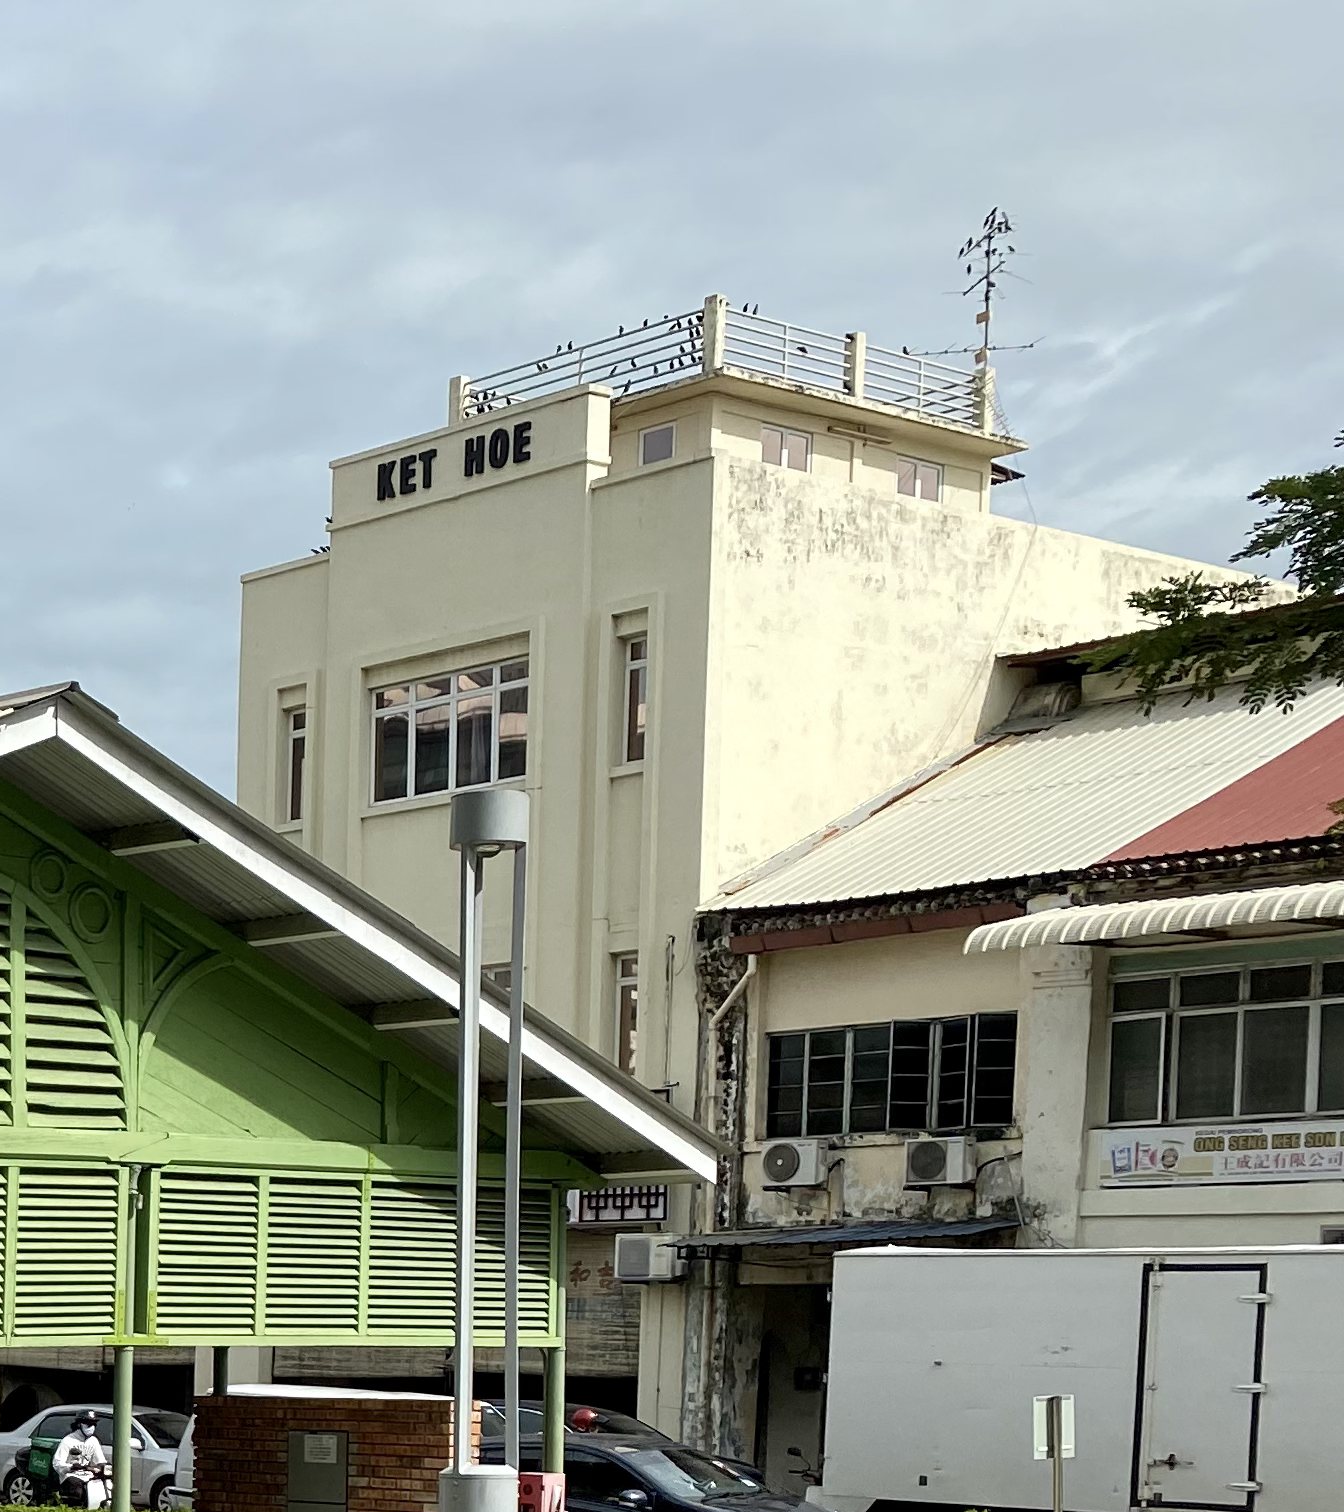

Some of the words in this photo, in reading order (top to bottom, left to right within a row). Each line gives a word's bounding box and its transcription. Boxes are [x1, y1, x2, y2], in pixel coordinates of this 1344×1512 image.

[377, 448, 438, 501] KET
[464, 421, 532, 477] HOE
[1194, 1136, 1225, 1152] ONG
[1228, 1134, 1268, 1151] SENG
[1272, 1133, 1301, 1149] KEE
[1304, 1131, 1336, 1148] SDN
